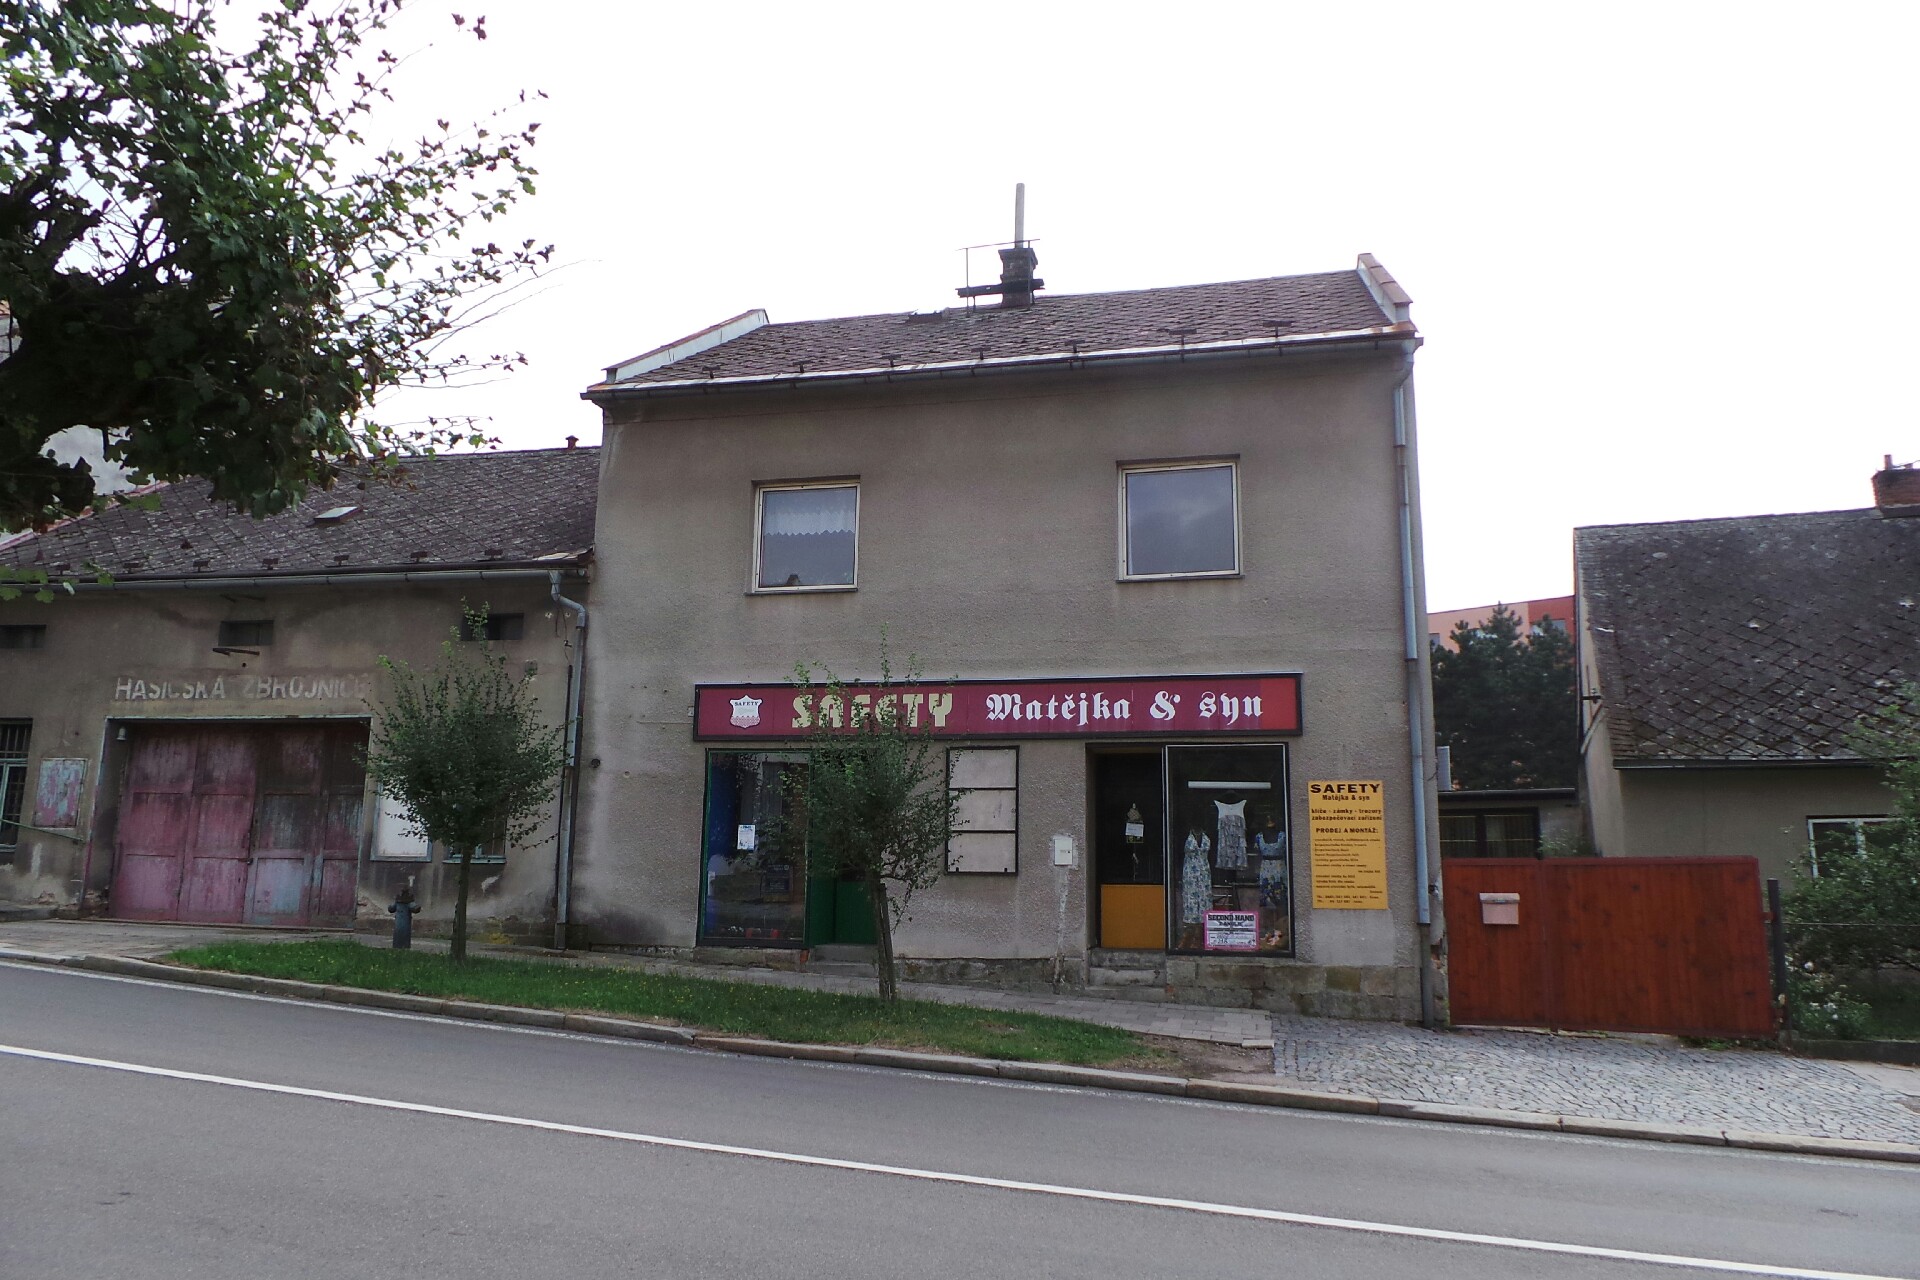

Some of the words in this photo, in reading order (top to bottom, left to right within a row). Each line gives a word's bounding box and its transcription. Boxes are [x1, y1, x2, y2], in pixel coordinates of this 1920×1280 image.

[791, 693, 953, 728] SAFETY
[985, 692, 1132, 726] Matějka
[1149, 690, 1181, 721] &
[1198, 691, 1264, 725] syn
[1310, 783, 1380, 793] SAFETY
